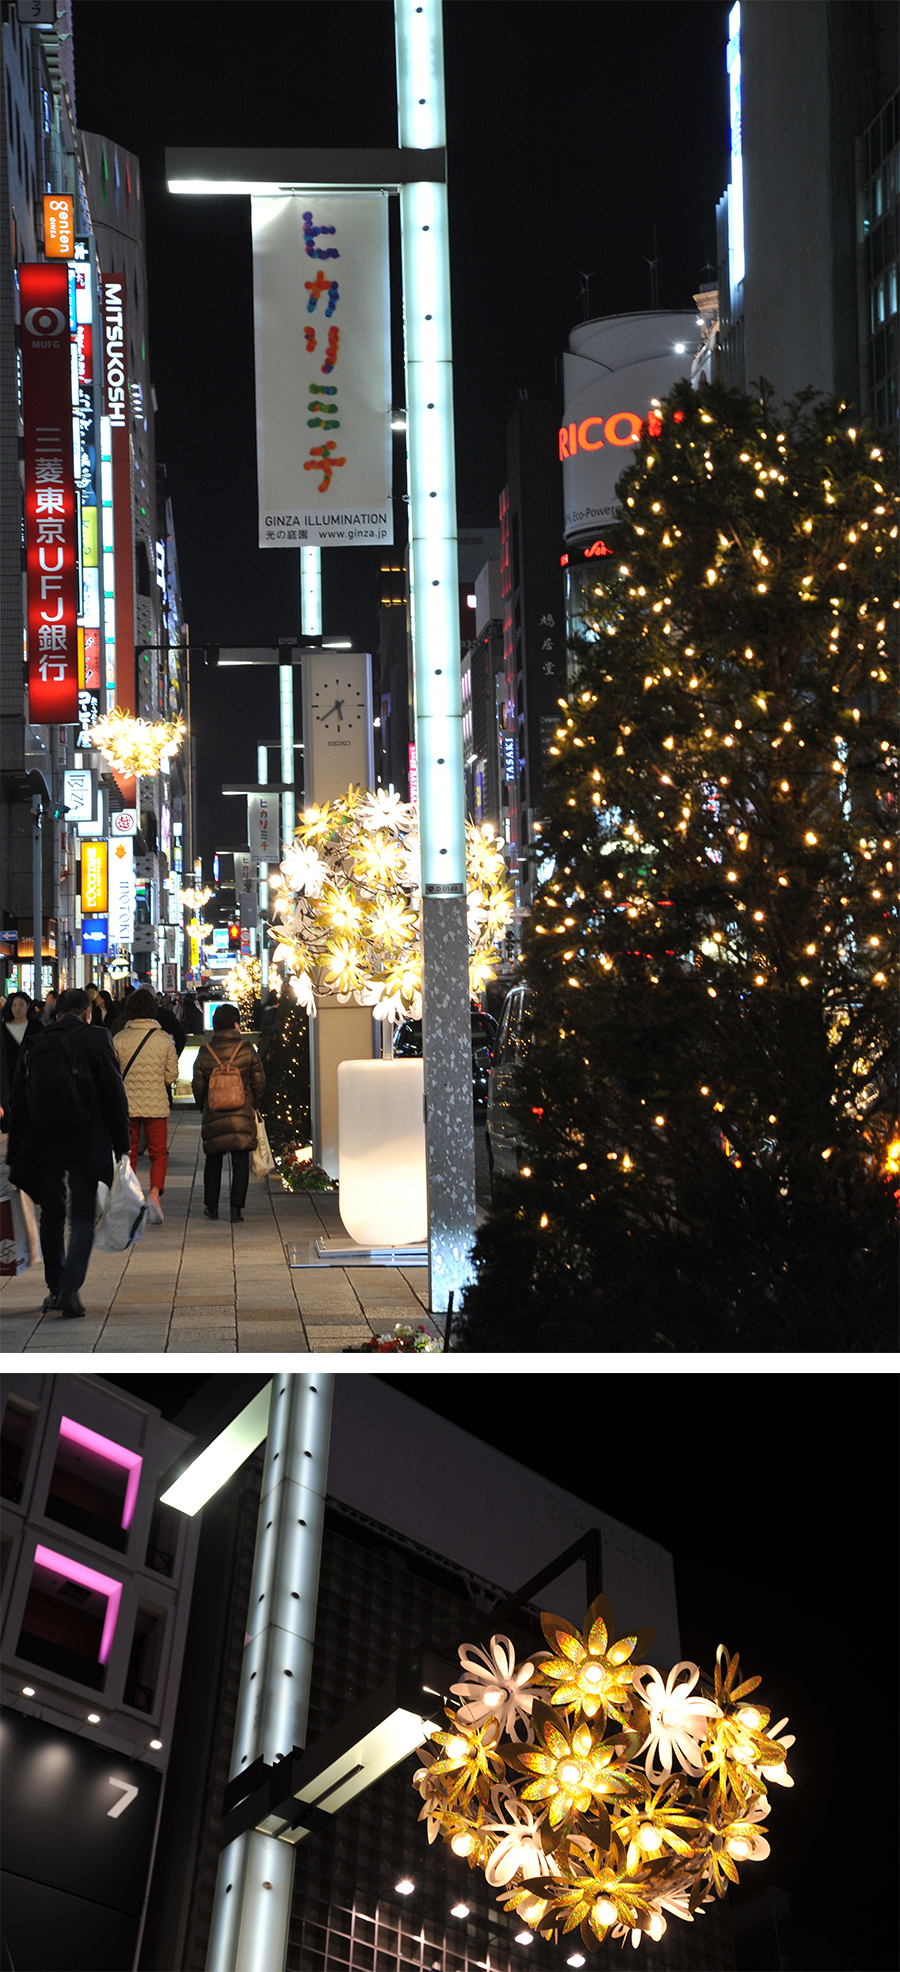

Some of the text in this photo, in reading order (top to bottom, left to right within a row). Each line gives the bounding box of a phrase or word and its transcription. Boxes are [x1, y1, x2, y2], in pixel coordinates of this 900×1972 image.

[49, 200, 71, 253] genten
[49, 217, 57, 239] GINZA
[32, 340, 60, 349] MUFG
[104, 283, 126, 427] MITSUKOSHI
[302, 211, 347, 493] ヒカリミチ
[265, 513, 387, 527] GINZA ILLUMINATION
[265, 527, 387, 540] 光の庭園 www.ginza.jp
[572, 504, 625, 522] Eco-Powere
[35, 427, 68, 682] 三菱東京UFJ銀行
[539, 613, 556, 676] 鳩居堂
[505, 737, 514, 782] TASAKI
[67, 774, 89, 811] IBIZA
[259, 798, 269, 851] ヒカリミチ
[106, 1776, 139, 1819] 7
